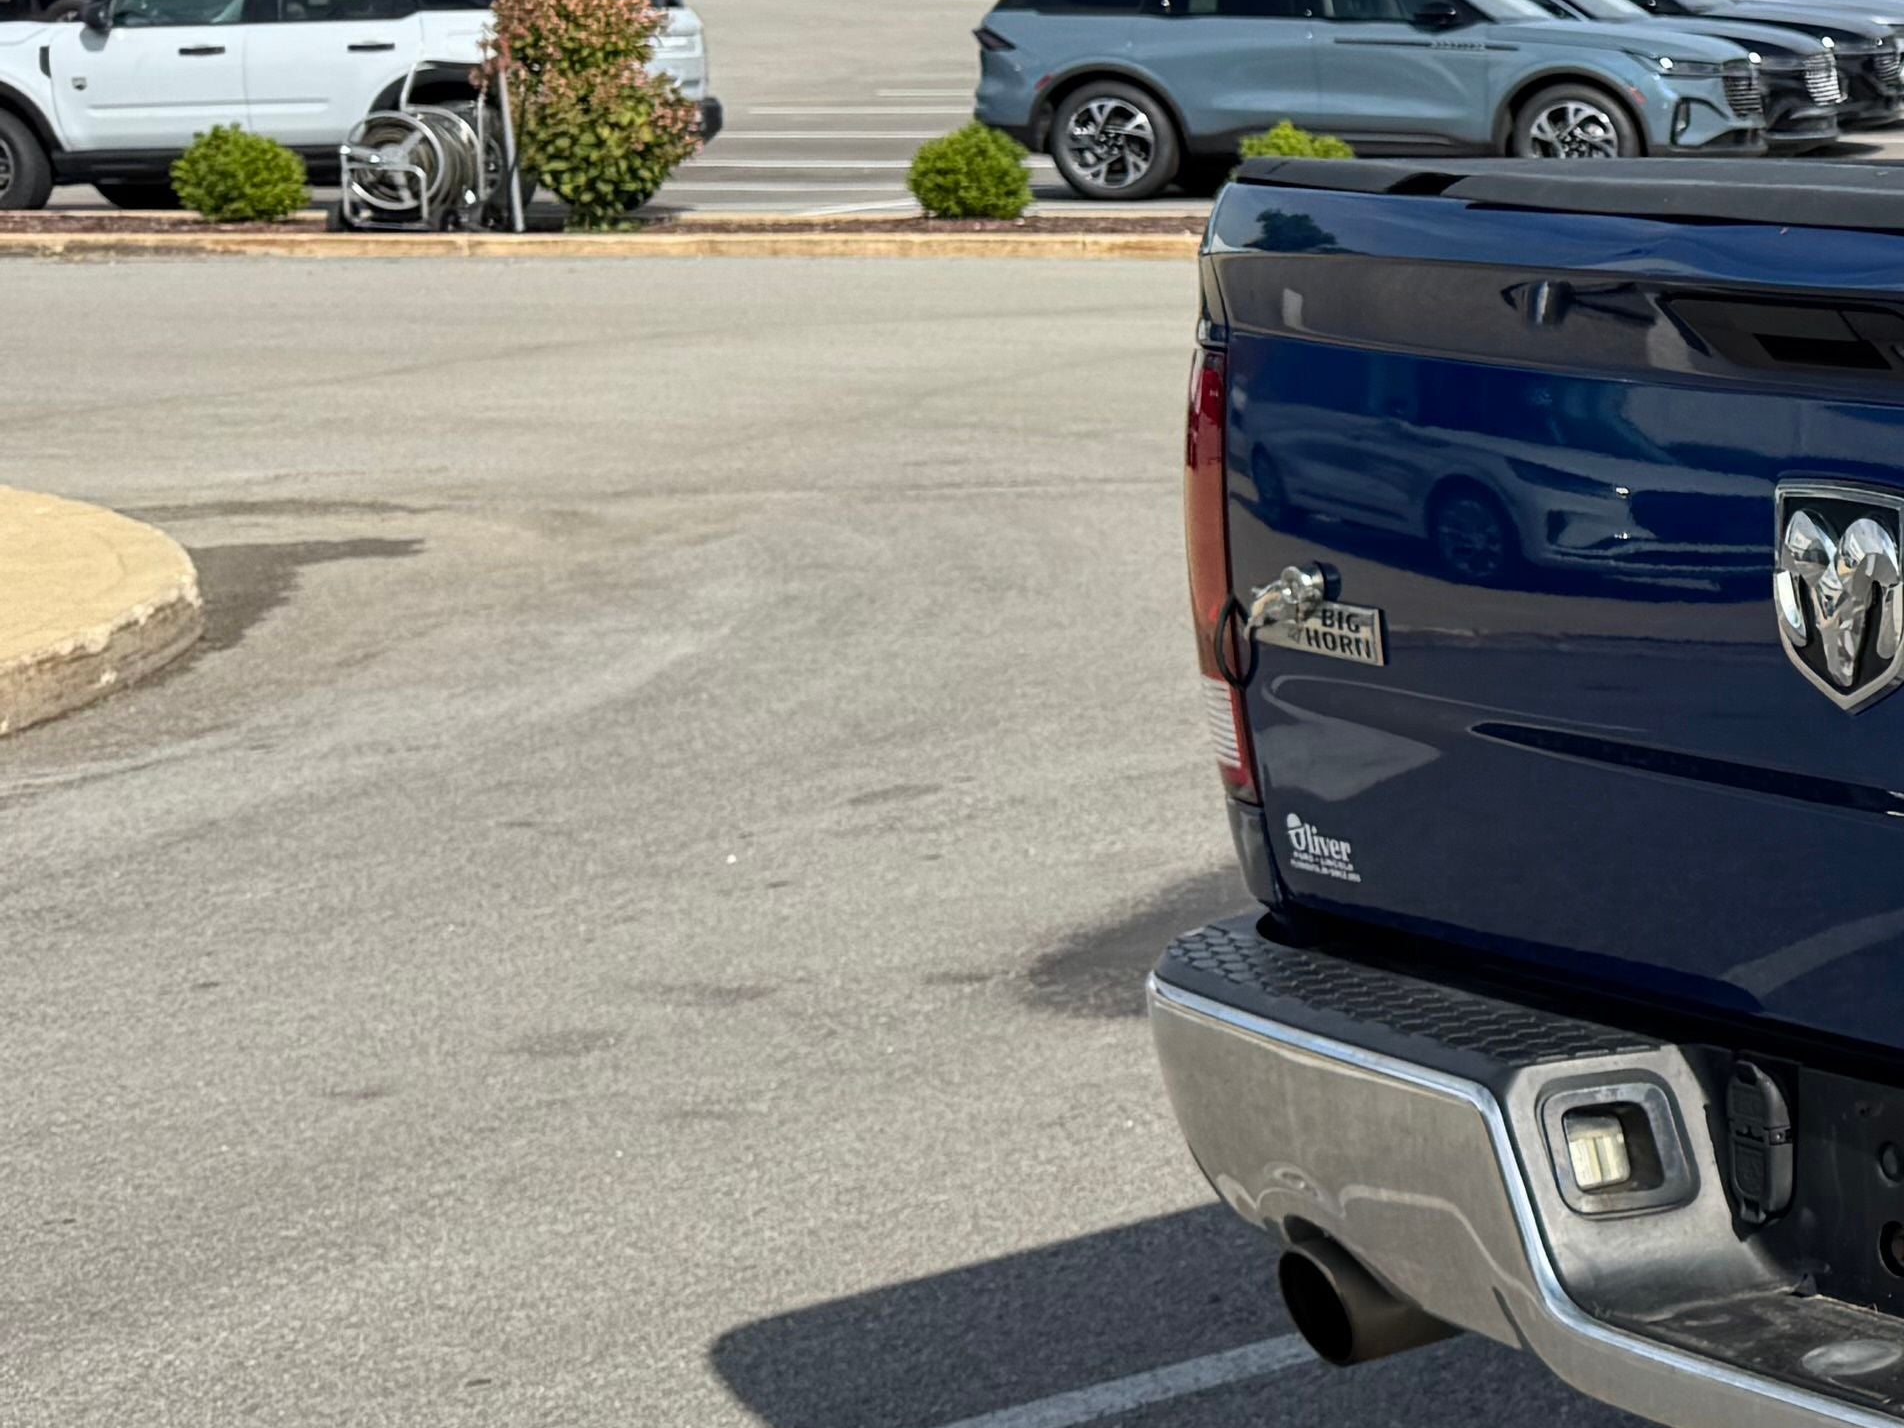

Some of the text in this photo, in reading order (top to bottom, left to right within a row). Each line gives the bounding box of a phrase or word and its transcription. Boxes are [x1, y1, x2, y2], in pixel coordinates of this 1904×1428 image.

[1321, 608, 1361, 633] BIG
[1306, 627, 1372, 659] HORN
[1287, 815, 1352, 861] Oliver
